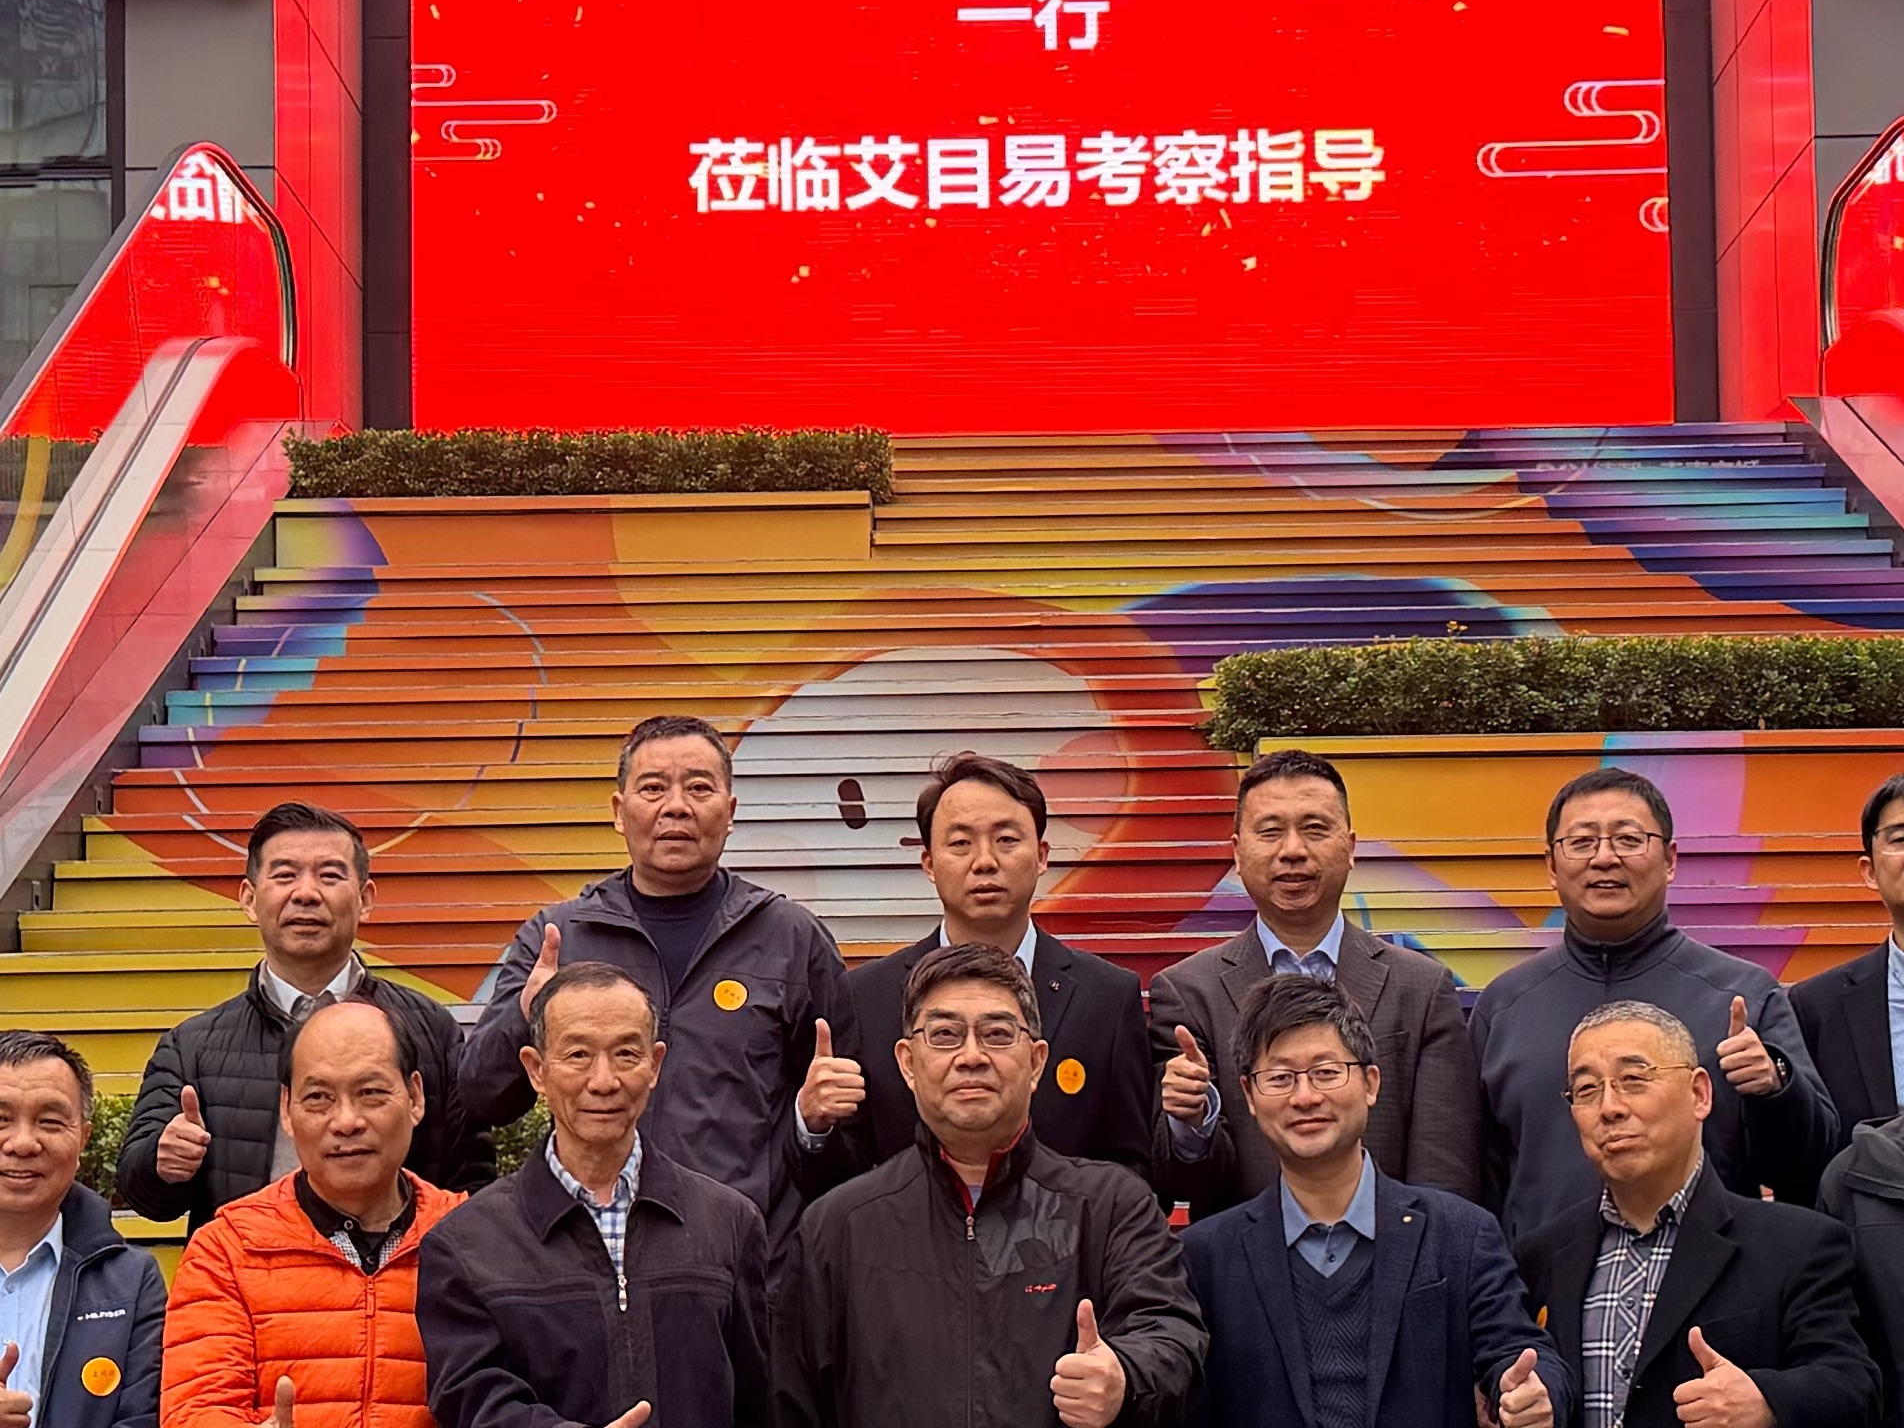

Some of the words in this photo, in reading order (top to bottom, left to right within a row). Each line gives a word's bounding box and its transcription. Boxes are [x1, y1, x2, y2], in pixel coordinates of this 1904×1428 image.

[688, 129, 1387, 213] 莅临艾目易考察指导
